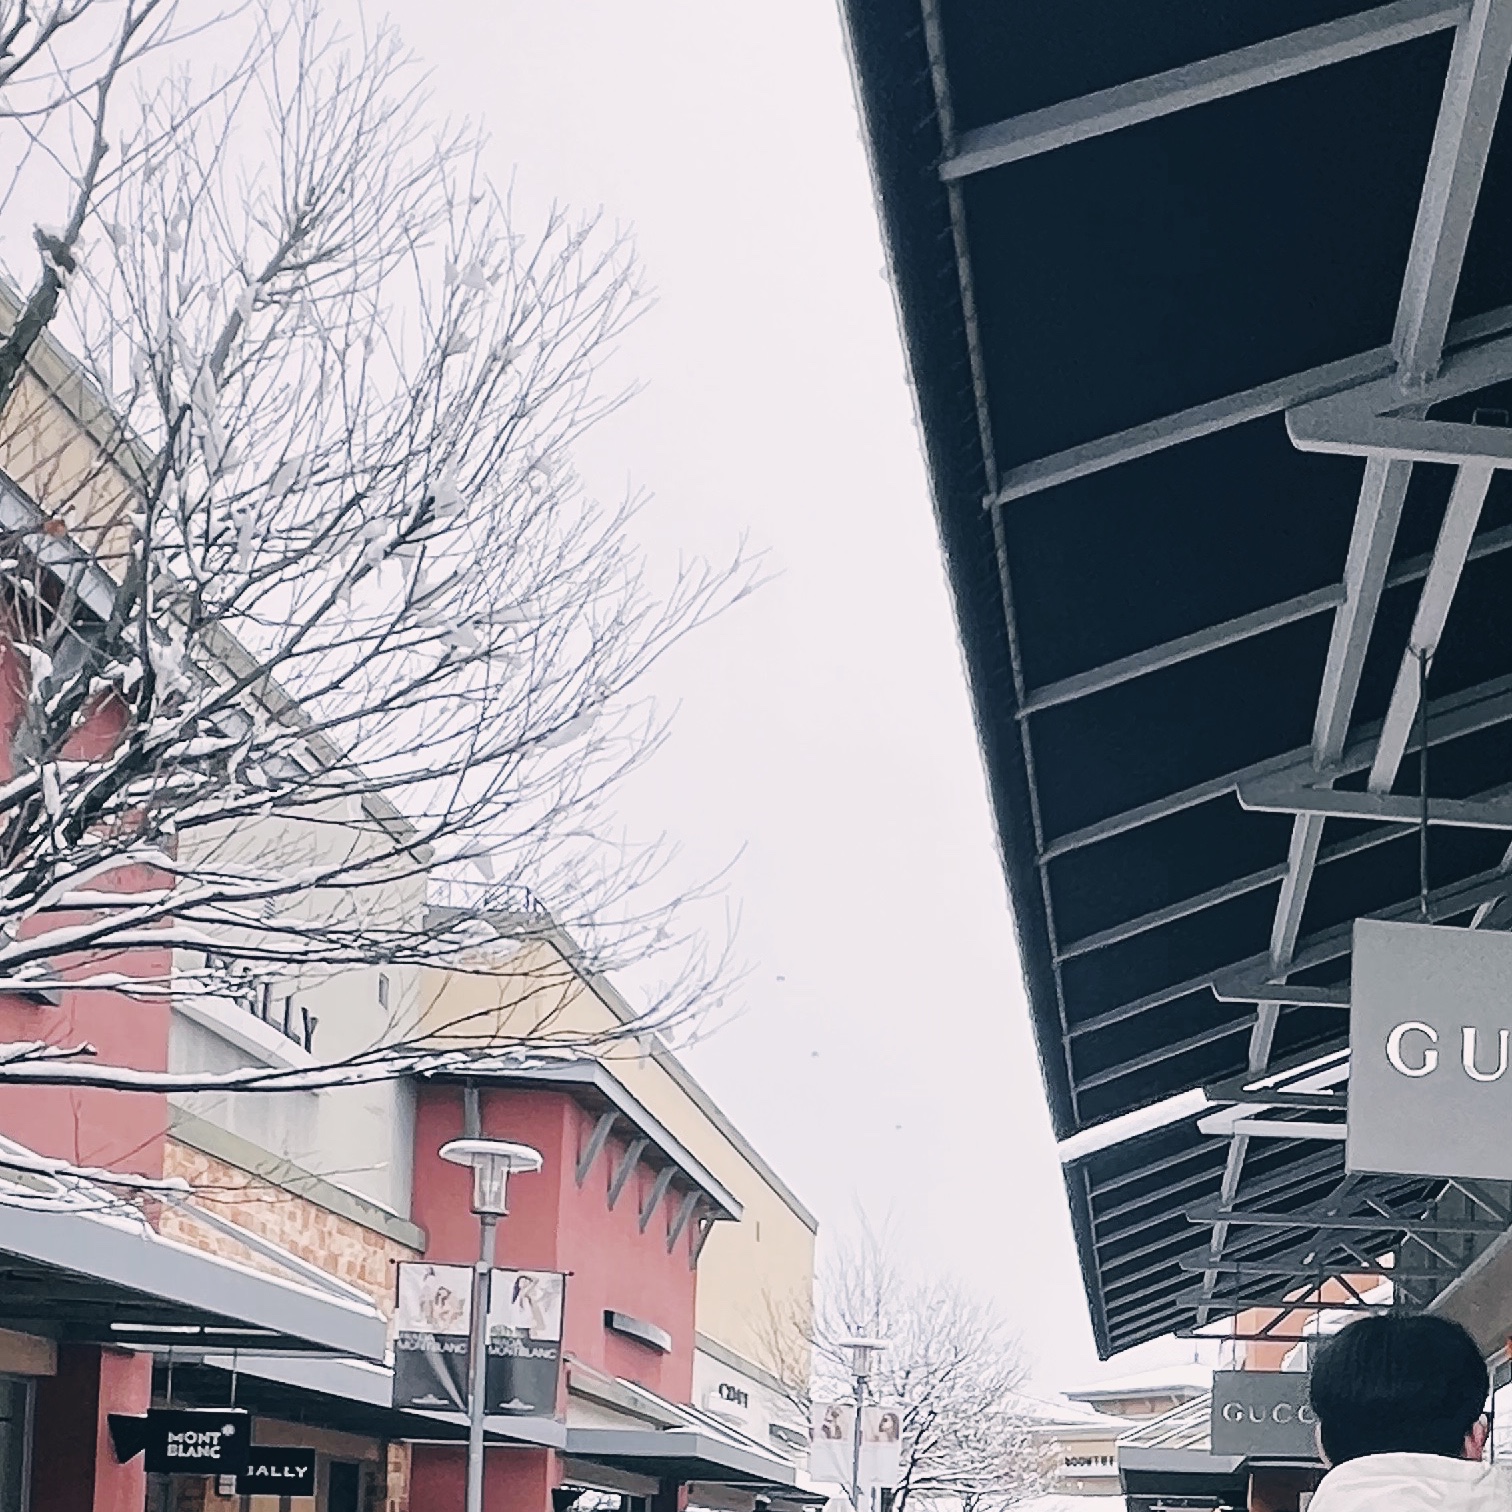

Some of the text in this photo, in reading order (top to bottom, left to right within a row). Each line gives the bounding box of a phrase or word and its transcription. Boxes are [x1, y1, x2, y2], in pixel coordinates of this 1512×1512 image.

[206, 951, 319, 1055] LLY
[1222, 1402, 1317, 1424] GUCC
[167, 1431, 222, 1444] MONT
[166, 1444, 221, 1459] BLANC
